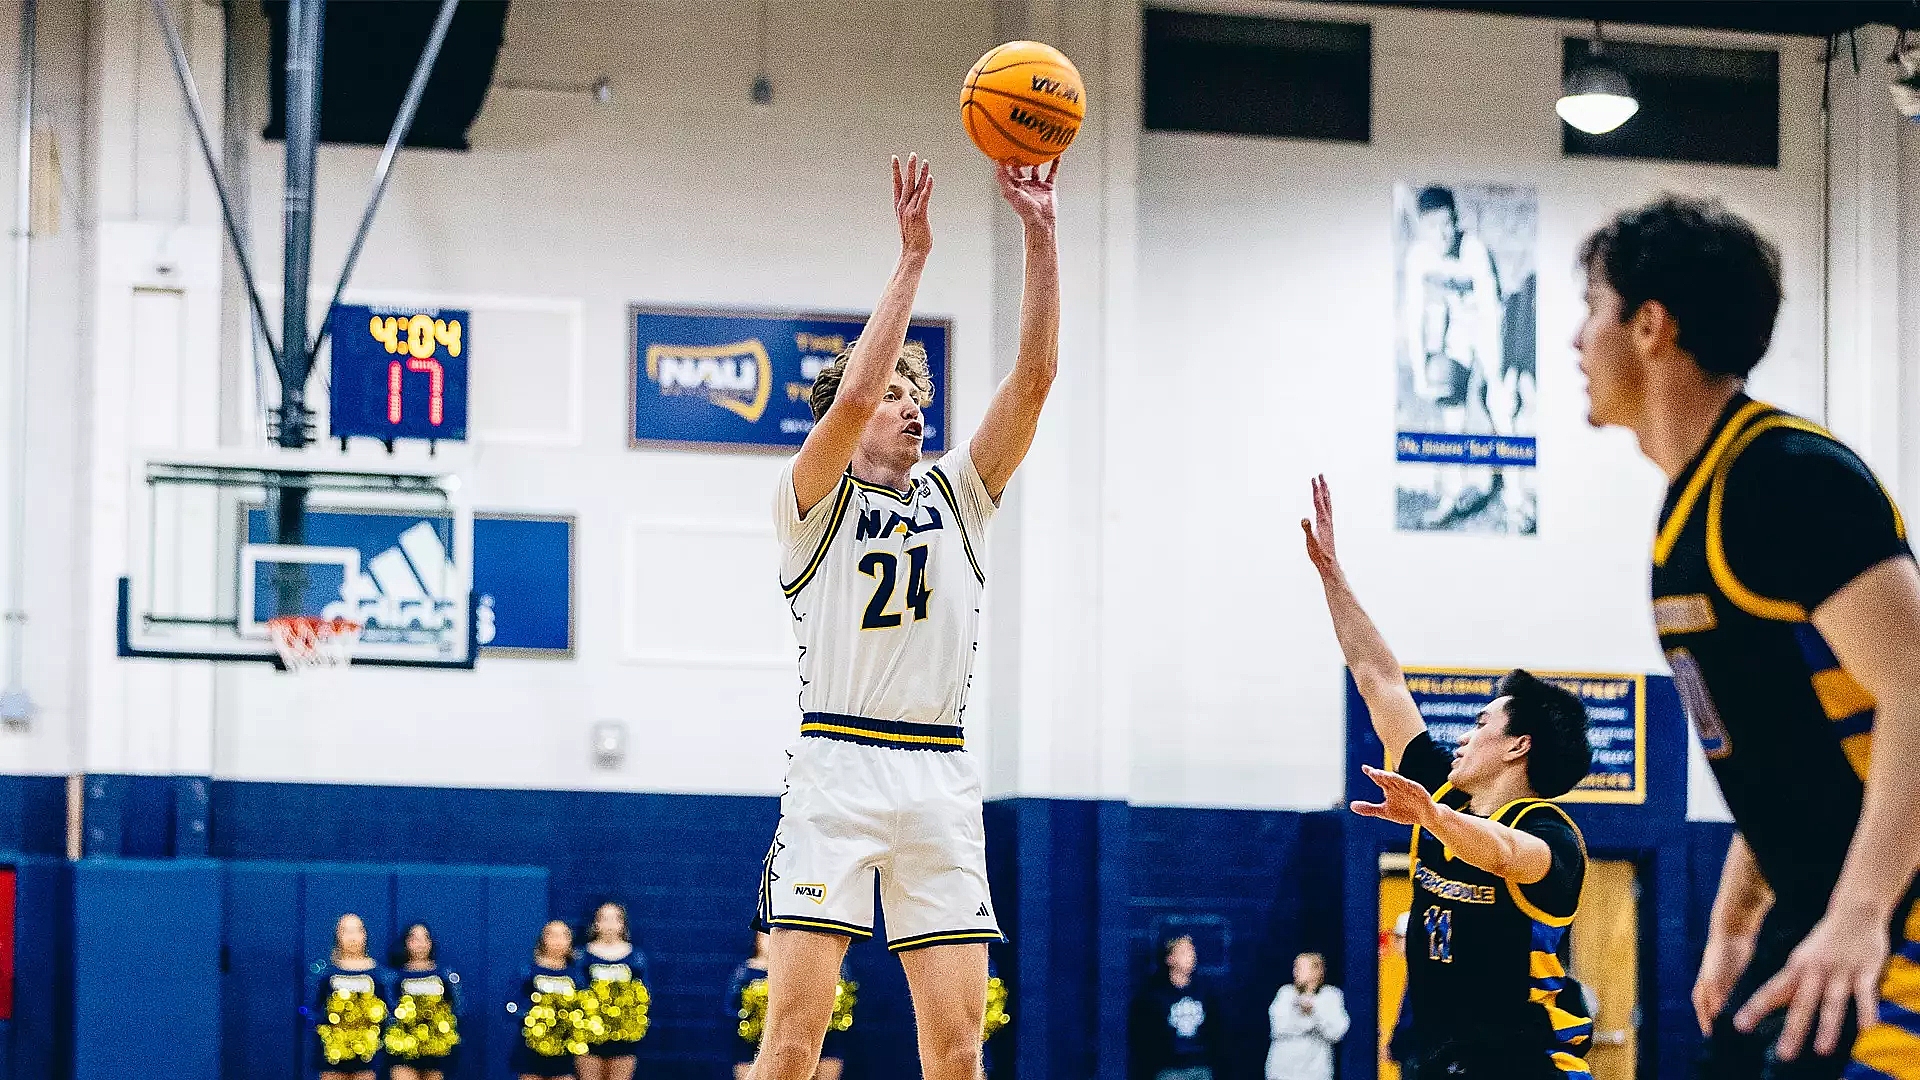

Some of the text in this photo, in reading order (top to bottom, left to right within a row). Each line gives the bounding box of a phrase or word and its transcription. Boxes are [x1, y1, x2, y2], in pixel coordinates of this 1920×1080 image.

[1031, 74, 1079, 103] NCAA
[1010, 107, 1076, 145] Wilson
[369, 314, 462, 357] 4:04
[387, 357, 445, 427] 17
[658, 356, 758, 390] NAU
[855, 505, 944, 542] NAU
[857, 543, 934, 632] 24
[794, 885, 823, 899] NAU
[1423, 905, 1454, 964] 11
